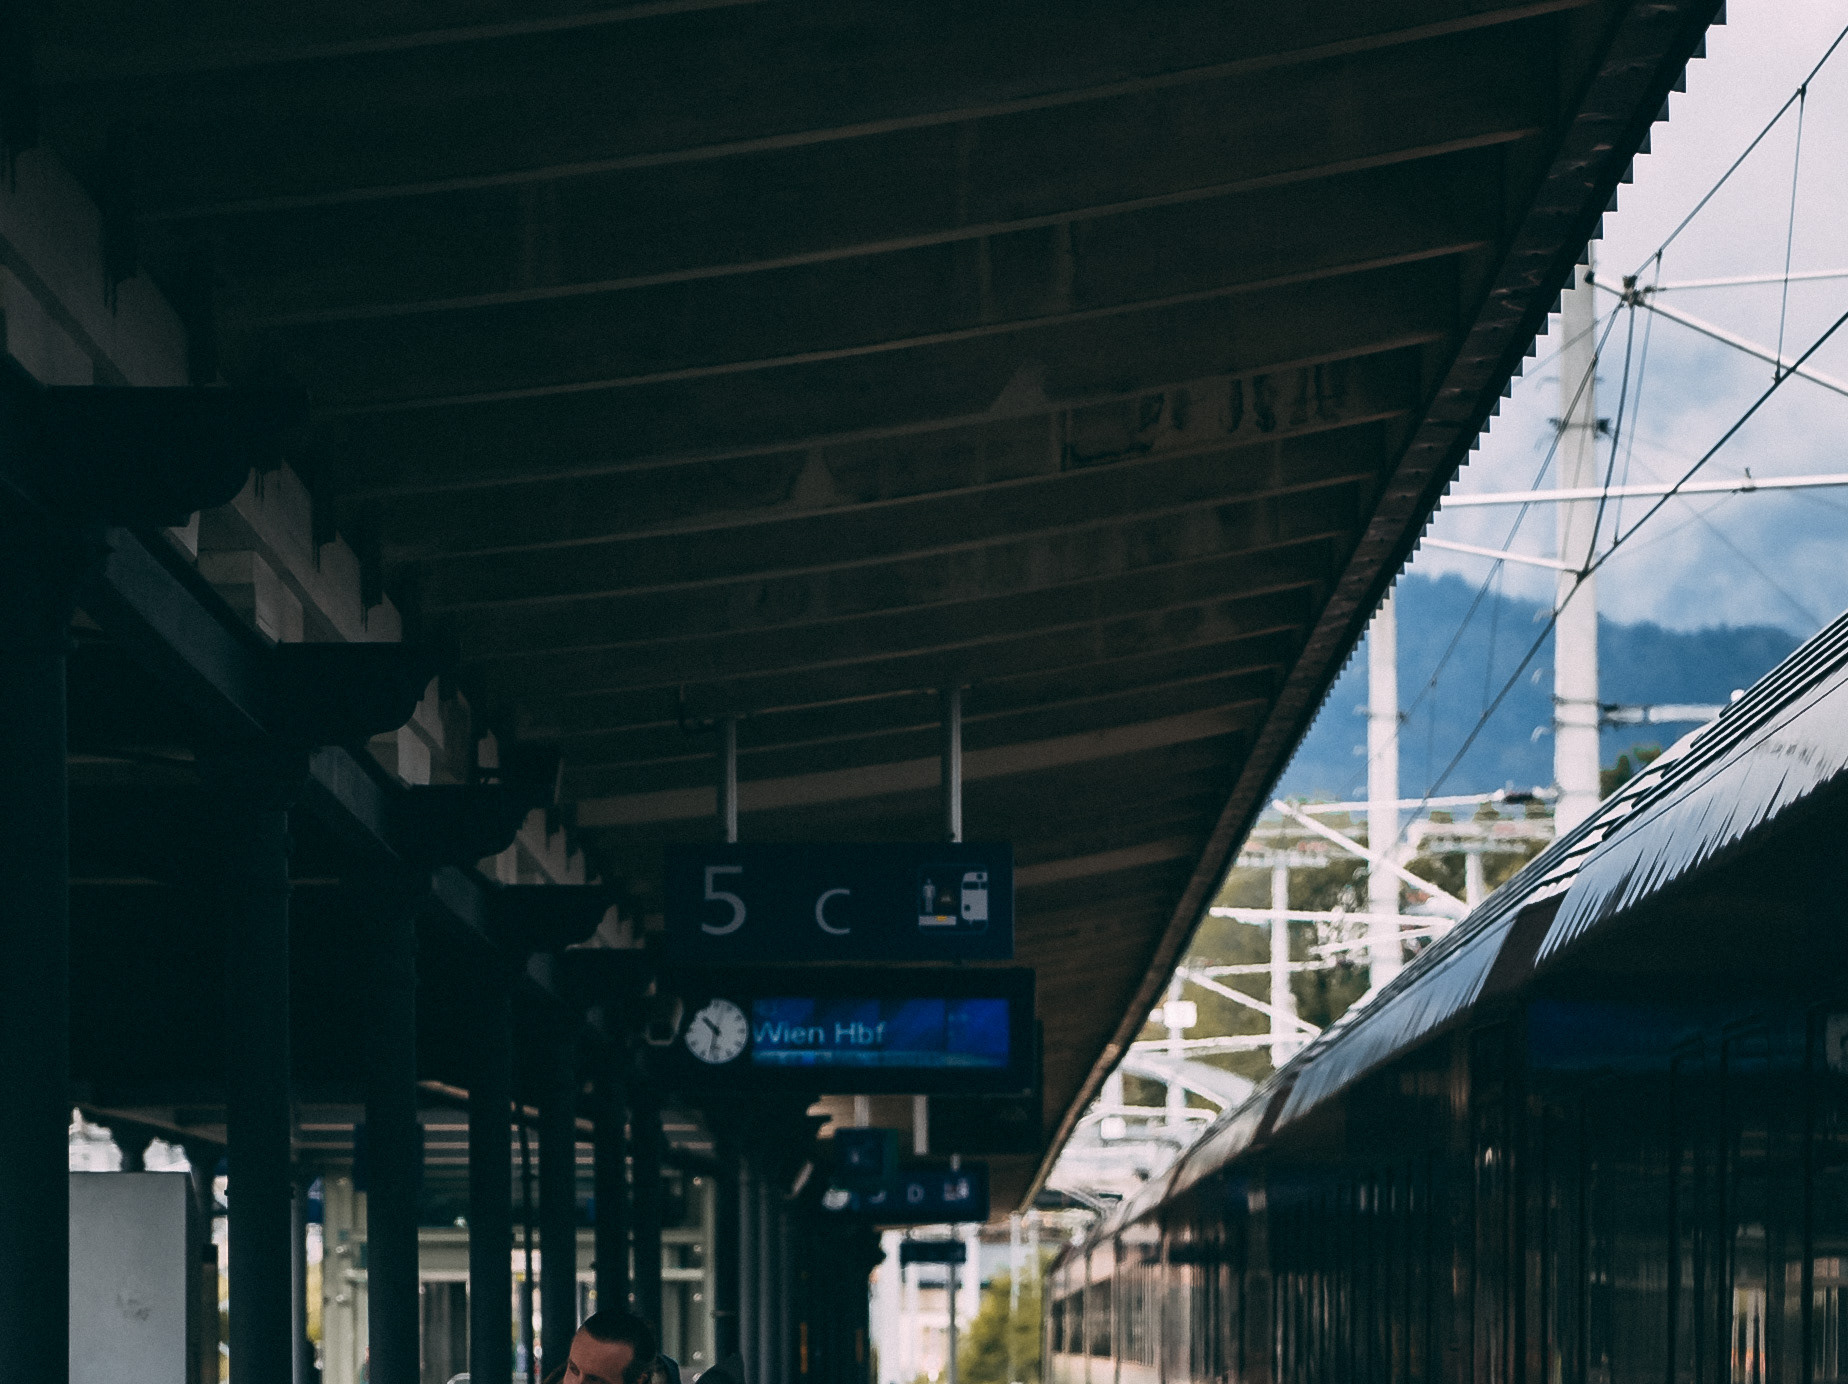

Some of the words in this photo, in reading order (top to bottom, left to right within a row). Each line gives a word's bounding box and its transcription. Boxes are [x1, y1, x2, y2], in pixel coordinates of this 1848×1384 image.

[701, 865, 746, 936] 5
[815, 888, 851, 935] C
[753, 1021, 824, 1044] Wien
[834, 1021, 886, 1044] Hbf
